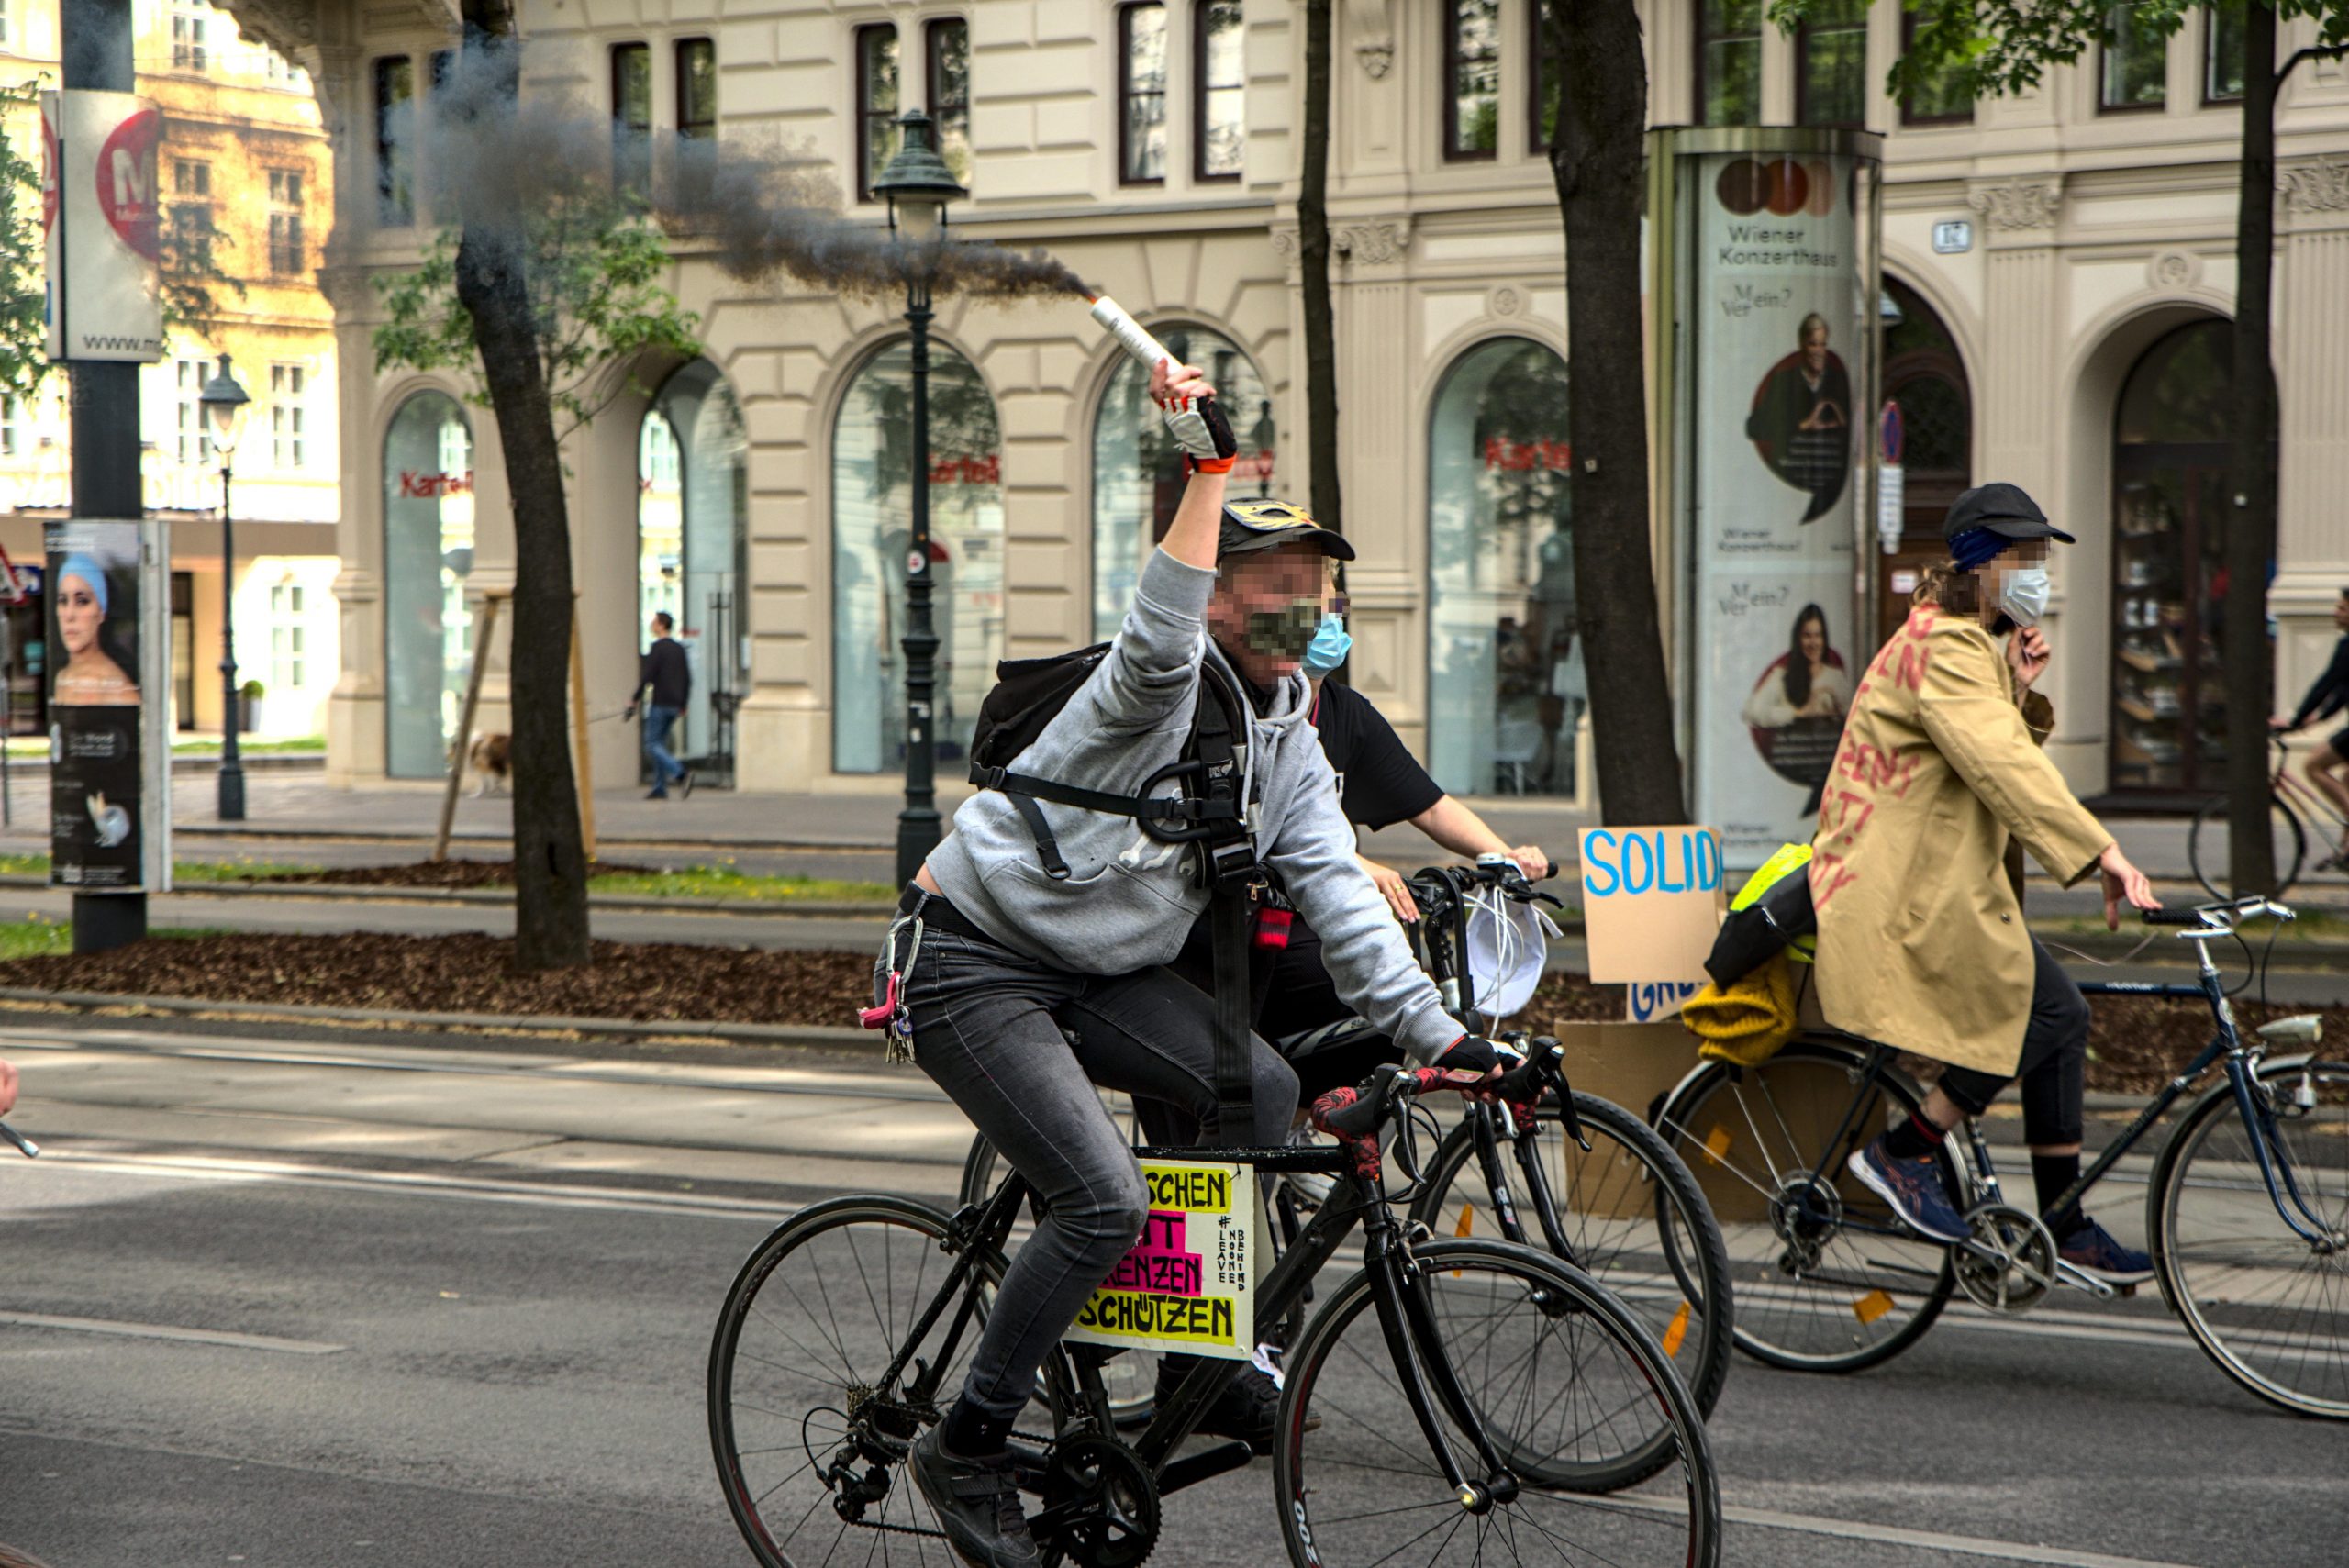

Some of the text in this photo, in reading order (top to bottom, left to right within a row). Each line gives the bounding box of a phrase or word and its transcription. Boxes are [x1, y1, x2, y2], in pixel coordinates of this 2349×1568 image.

[1728, 226, 1804, 243] Wiener
[1719, 248, 1839, 267] Konzerthaus
[1486, 436, 1571, 471] Karte
[1146, 1172, 1226, 1208] SCHEN
[1102, 1255, 1201, 1294] ENZEN
[1079, 1293, 1234, 1338] SCHÜTZEN
